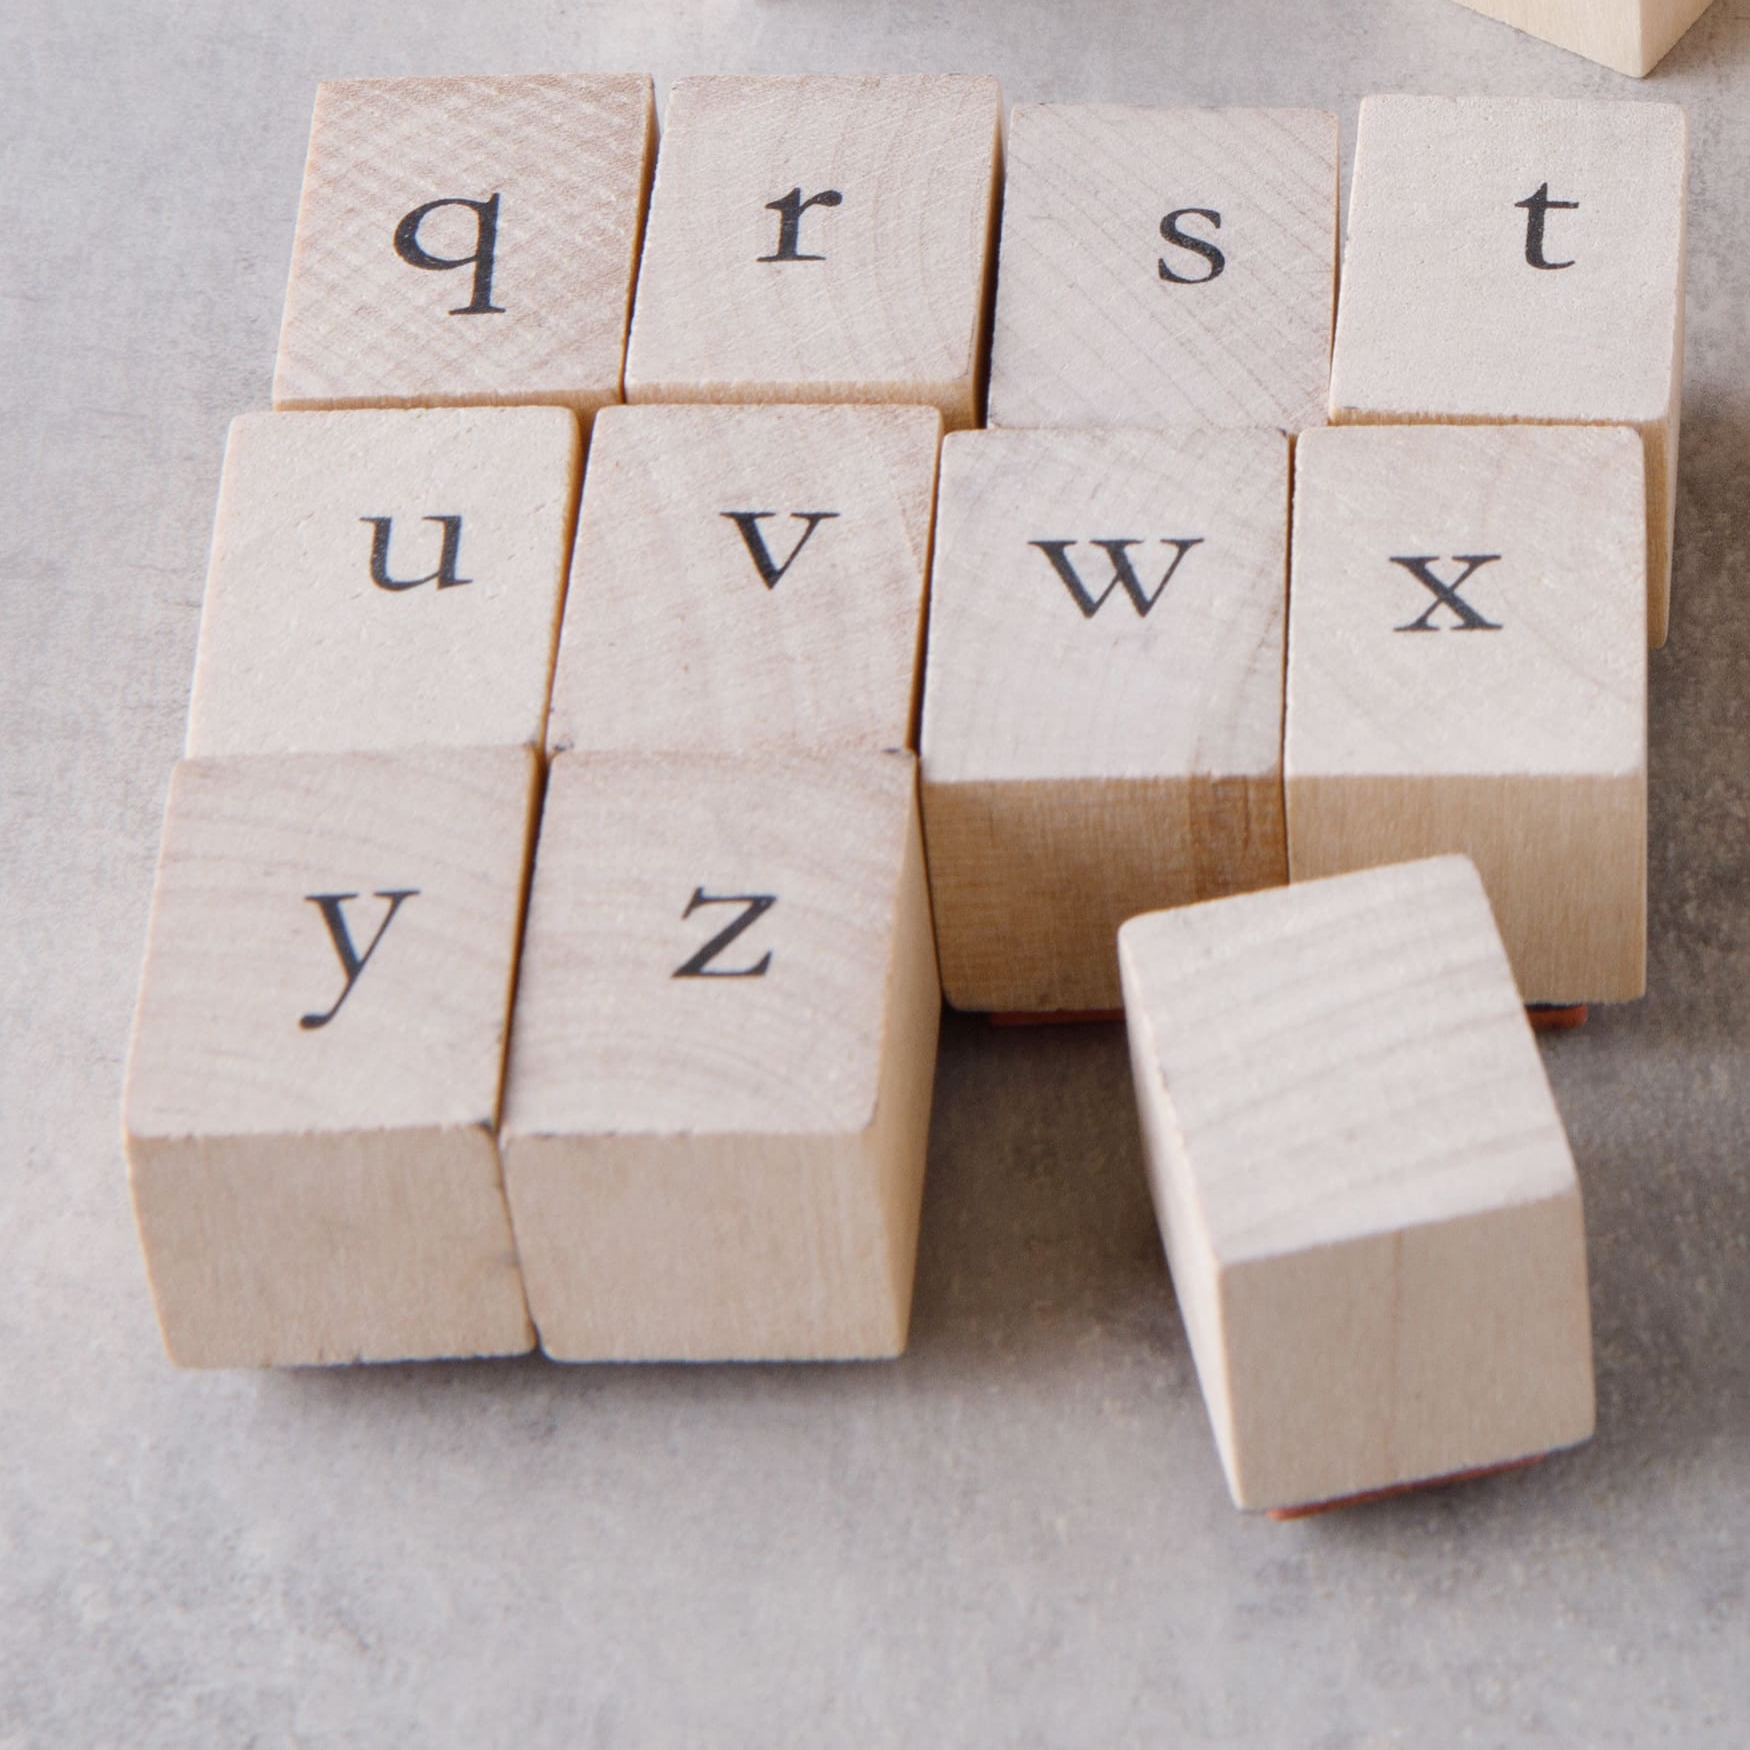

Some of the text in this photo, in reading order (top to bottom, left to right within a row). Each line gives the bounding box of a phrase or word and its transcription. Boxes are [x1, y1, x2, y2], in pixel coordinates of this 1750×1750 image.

[394, 193, 505, 315] q
[758, 188, 842, 262] r
[1159, 209, 1225, 284] s
[1515, 183, 1579, 270] t
[362, 516, 470, 591] u
[721, 512, 838, 589] v
[1030, 539, 1203, 618] w
[1390, 555, 1501, 631] x
[300, 891, 418, 1029] y
[673, 888, 776, 978] z
